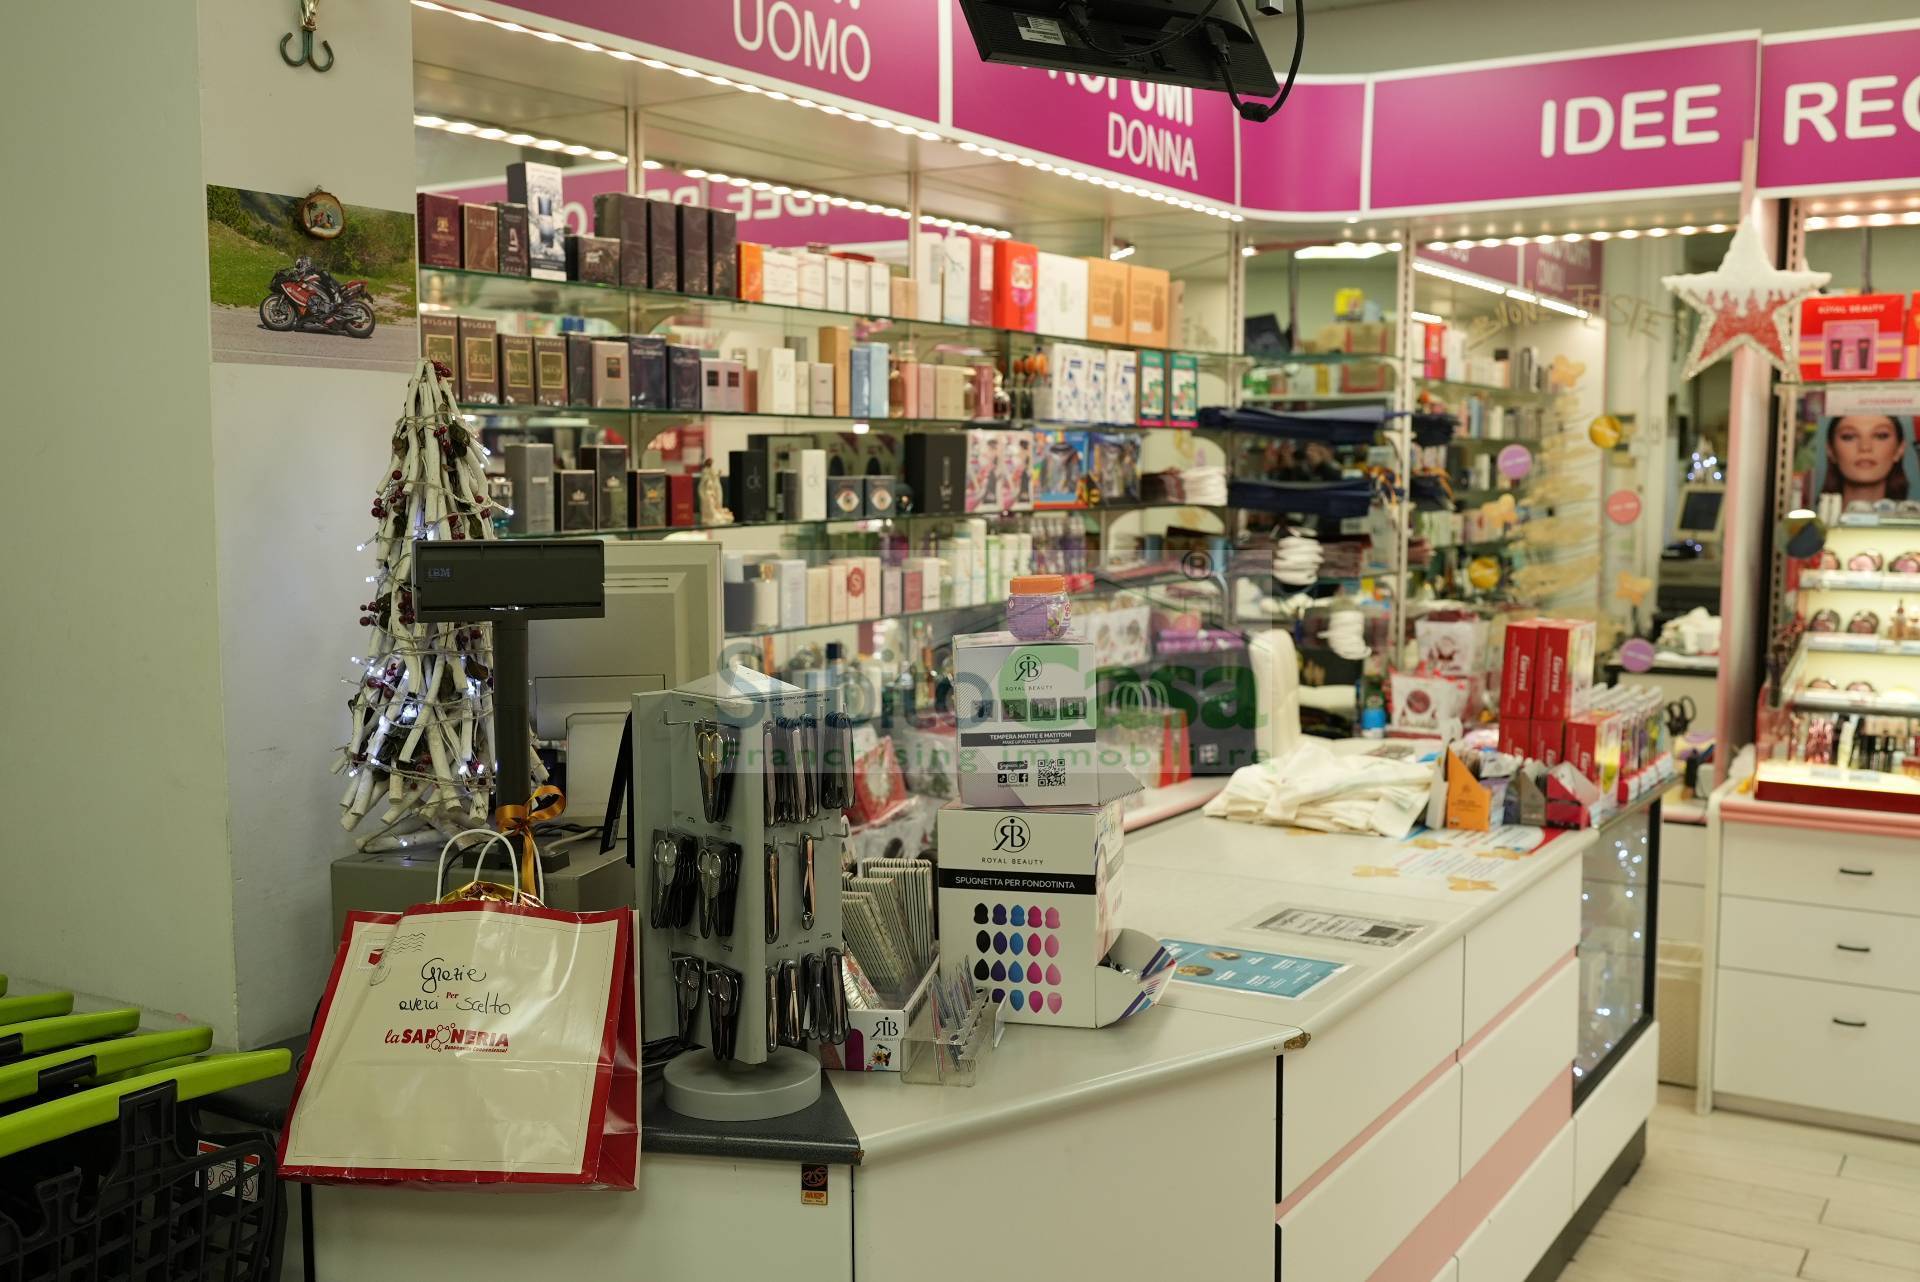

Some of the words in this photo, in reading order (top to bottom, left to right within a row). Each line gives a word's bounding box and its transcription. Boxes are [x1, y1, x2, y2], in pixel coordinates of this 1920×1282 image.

[733, 0, 871, 82] UOMO
[1541, 84, 1722, 158] IDEE
[1107, 111, 1198, 181] DONNA
[428, 567, 451, 578] IBM
[1044, 731, 1072, 739] MATITONI
[955, 876, 1004, 886] SPUGNETTA
[1005, 878, 1021, 887] PER
[1021, 879, 1076, 889] FONDOTINTA
[421, 957, 487, 993] Grazie
